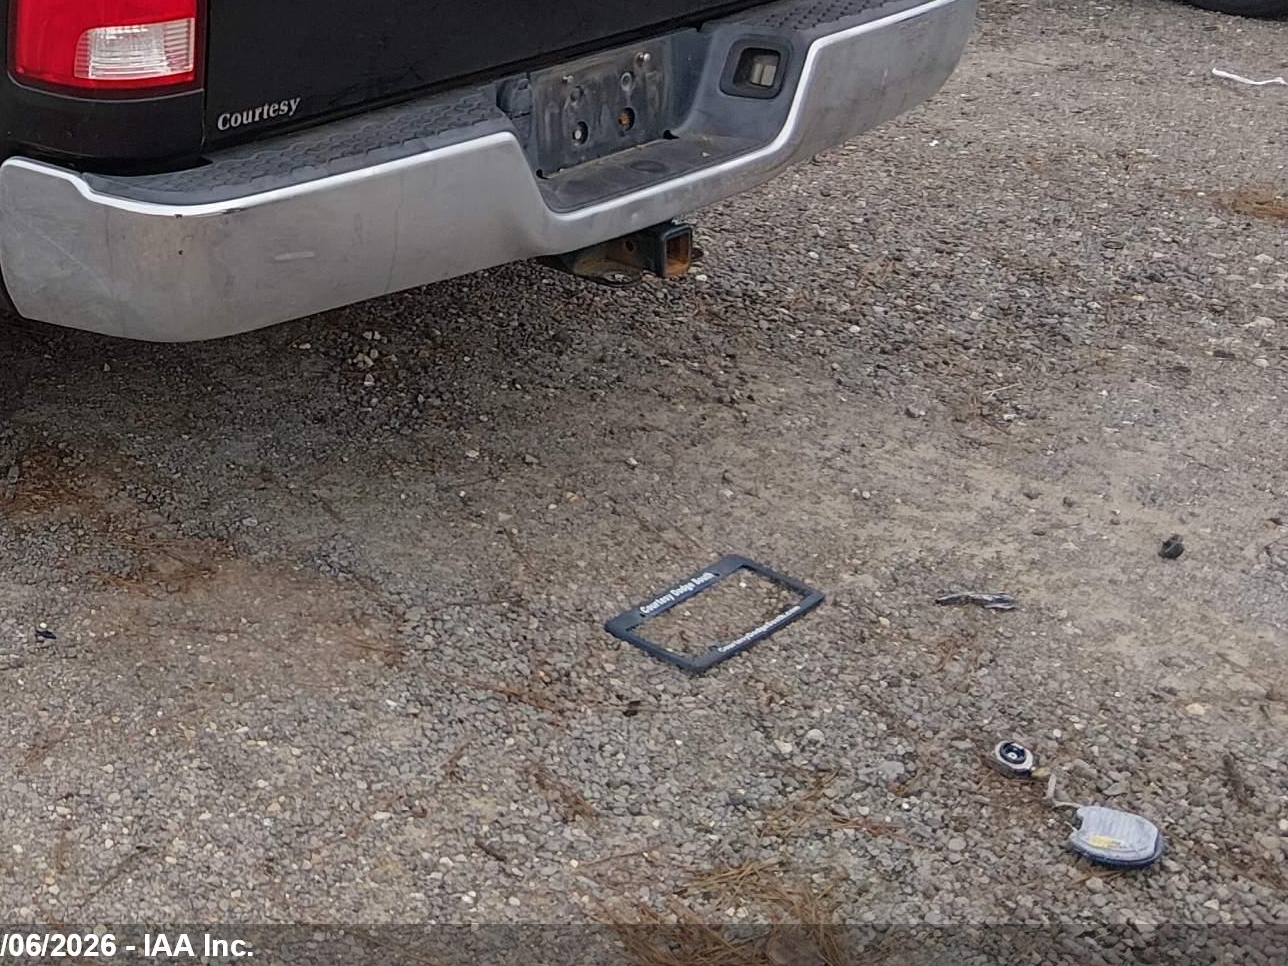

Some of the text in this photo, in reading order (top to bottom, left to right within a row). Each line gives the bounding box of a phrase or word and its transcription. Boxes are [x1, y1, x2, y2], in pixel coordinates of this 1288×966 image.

[217, 97, 301, 132] Courtesy
[639, 593, 675, 614] Courtesy
[669, 582, 696, 597] Dodge
